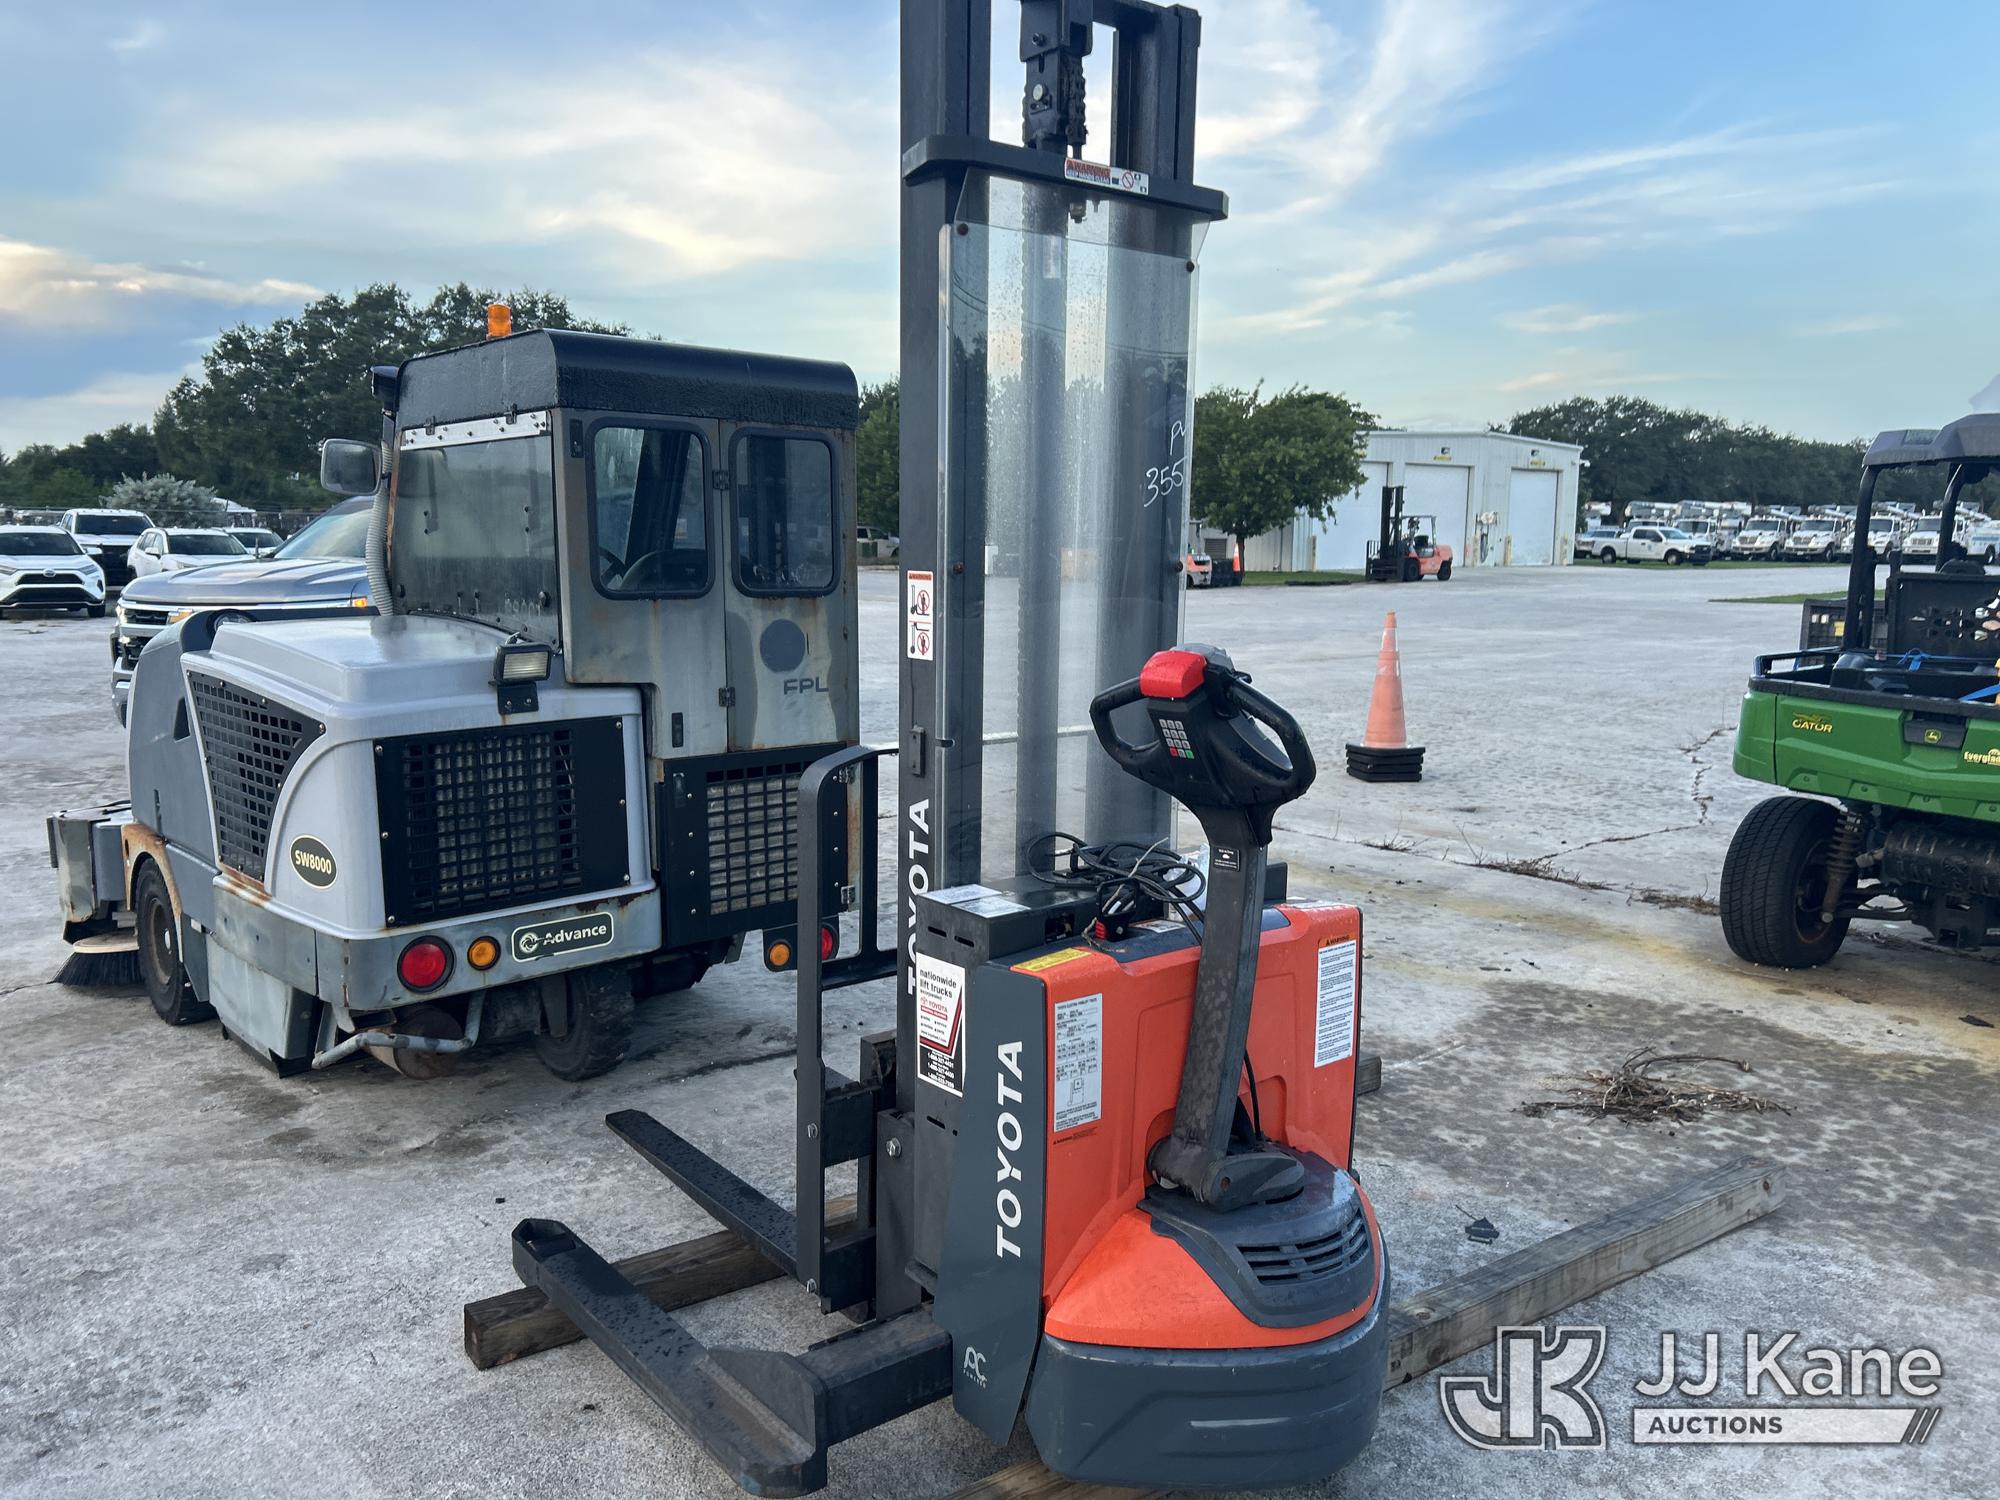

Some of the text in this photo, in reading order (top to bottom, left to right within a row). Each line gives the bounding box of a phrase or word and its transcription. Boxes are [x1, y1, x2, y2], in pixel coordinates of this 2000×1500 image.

[1143, 455, 1188, 507] 355
[784, 677, 829, 695] FPL
[1792, 719, 1833, 733] GATOR
[295, 849, 332, 875] SW8000
[543, 924, 607, 946] Advance
[919, 969, 957, 989] nationwide
[930, 983, 953, 999] trucks
[996, 1041, 1023, 1258] TOYOTA
